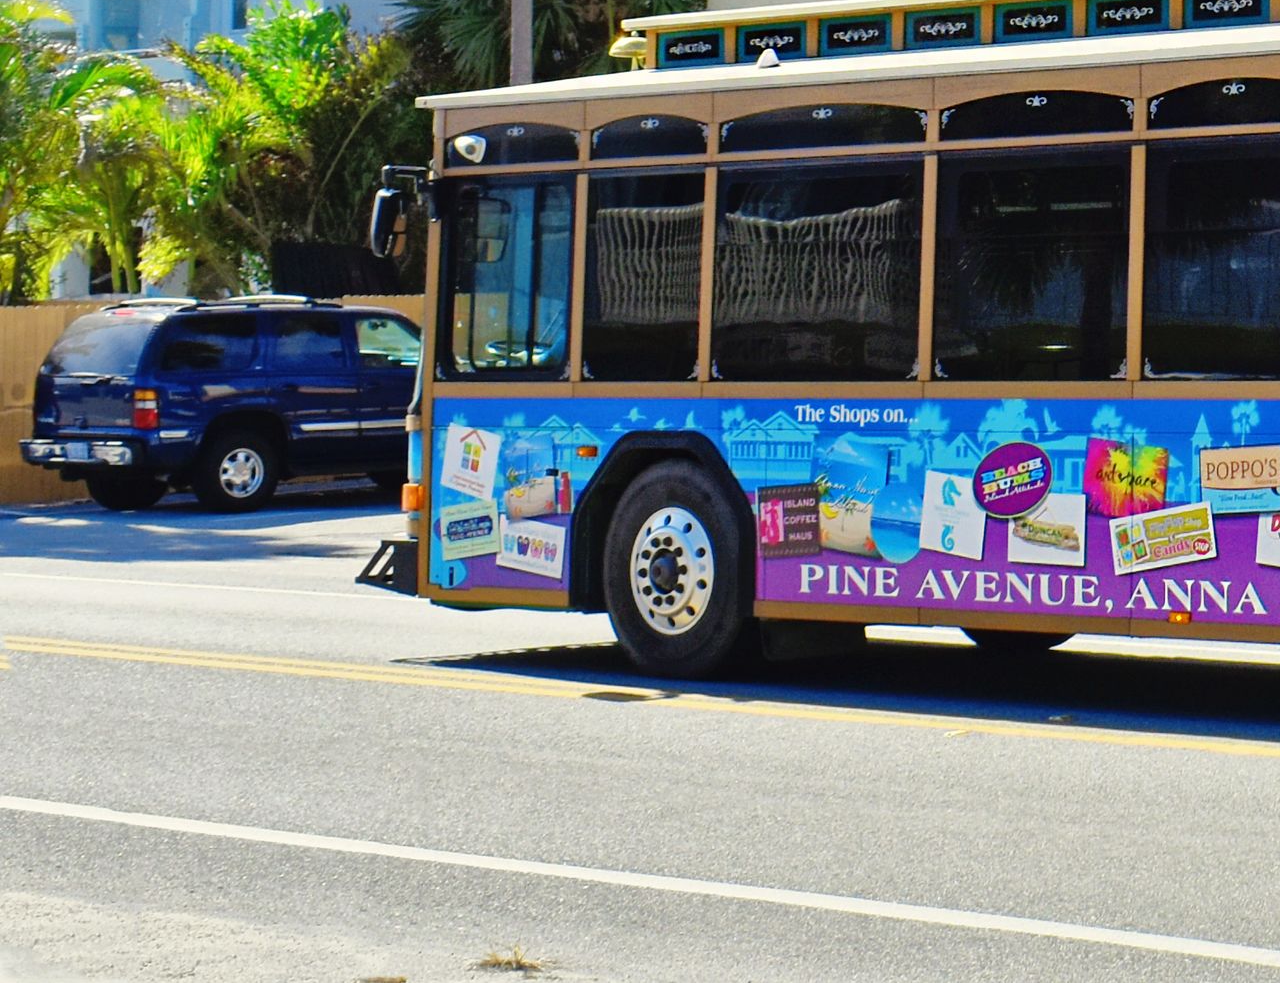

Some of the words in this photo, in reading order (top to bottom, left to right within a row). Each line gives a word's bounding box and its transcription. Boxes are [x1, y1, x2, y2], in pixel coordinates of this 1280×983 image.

[794, 404, 825, 423] The
[829, 404, 880, 427] Shops
[882, 409, 919, 424] on...
[981, 457, 1043, 483] BEACH
[1096, 463, 1158, 489] artspace
[1205, 458, 1278, 481] POPPO'S
[783, 497, 816, 509] ISLAND
[984, 489, 1011, 503] Island
[1010, 480, 1045, 497] Attitude
[783, 514, 818, 527] COFFEE
[1028, 522, 1063, 538] DUNCAN
[788, 531, 813, 542] HAUS
[1194, 541, 1210, 552] STOP
[798, 564, 900, 598] PINE
[915, 570, 1114, 614] AVENUE,
[1126, 578, 1267, 616] ANNA
